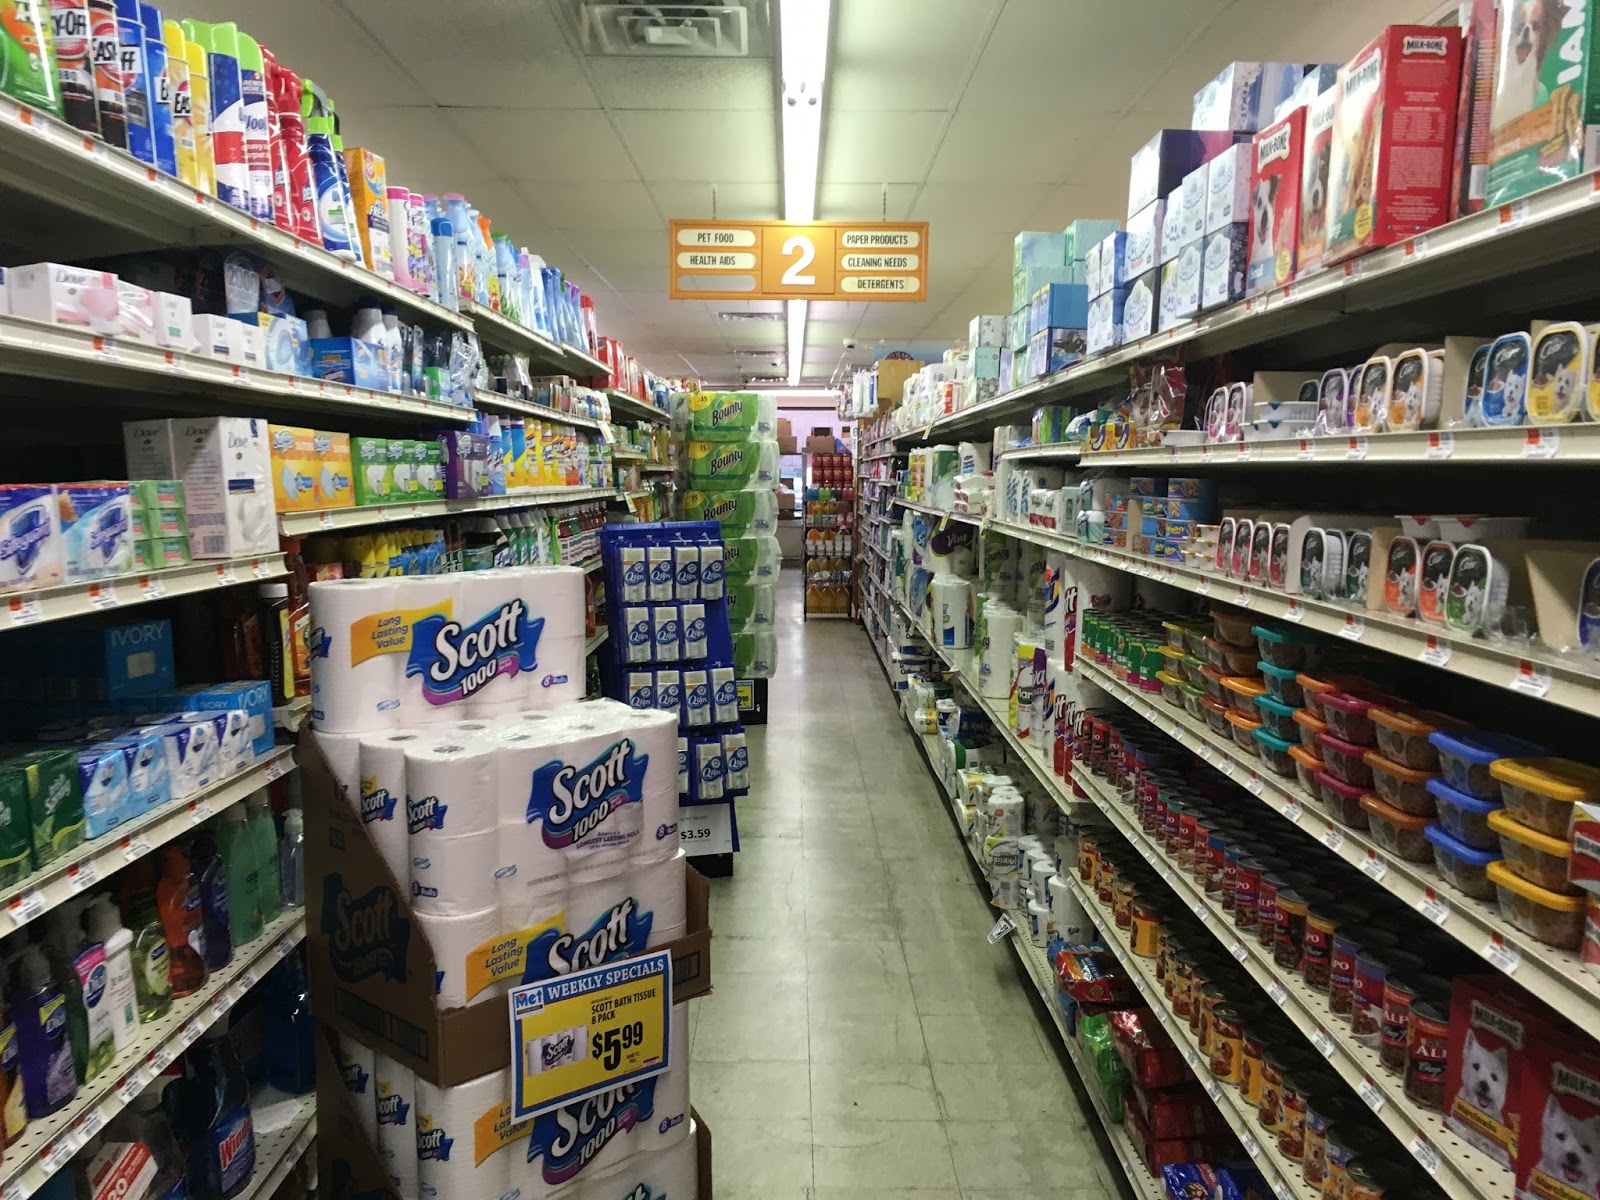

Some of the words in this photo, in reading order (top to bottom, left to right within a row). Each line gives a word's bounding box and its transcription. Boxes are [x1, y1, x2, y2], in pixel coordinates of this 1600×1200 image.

[1406, 40, 1443, 50] MILK-BONE
[1260, 131, 1288, 160] MILK-BONE
[697, 233, 711, 243] PET
[714, 232, 734, 243] FOOD
[846, 235, 869, 245] PAPER
[870, 235, 908, 245] PRODUCTS
[690, 256, 717, 266] HEALTH
[719, 256, 736, 266] AIDS
[780, 235, 816, 286] 2
[848, 257, 883, 268] CLEANING
[884, 258, 907, 268] NEEDS
[857, 279, 905, 289] DETERGENTS
[712, 401, 743, 428] Bounty
[228, 431, 249, 449] Dove
[710, 450, 743, 477] Bounty
[703, 499, 737, 521] Bounty
[378, 615, 402, 628] Long
[111, 623, 165, 648] IVORY
[371, 625, 409, 640] Lasting
[430, 599, 523, 682] Scott
[376, 636, 406, 649] Value
[461, 658, 497, 696] 1000
[543, 676, 550, 686] 8
[238, 685, 269, 711] IVORY
[548, 741, 631, 824] Scott
[572, 800, 609, 843] 1000
[659, 827, 665, 837] 8
[680, 828, 711, 840] $3.59
[491, 937, 517, 954] Long
[549, 899, 632, 974] Scott
[485, 947, 524, 968] Lasting
[491, 958, 520, 976] Value
[547, 974, 603, 1000] WEEKLY
[605, 959, 664, 985] SPECIALS
[515, 989, 542, 1009] Met
[591, 1001, 613, 1015] SCOTT
[614, 995, 632, 1009] BATH
[633, 988, 656, 1002] TISSUE
[591, 1015, 597, 1025] 8
[598, 1010, 615, 1023] PACK
[661, 1120, 668, 1131] 8
[579, 1118, 616, 1166] 1000
